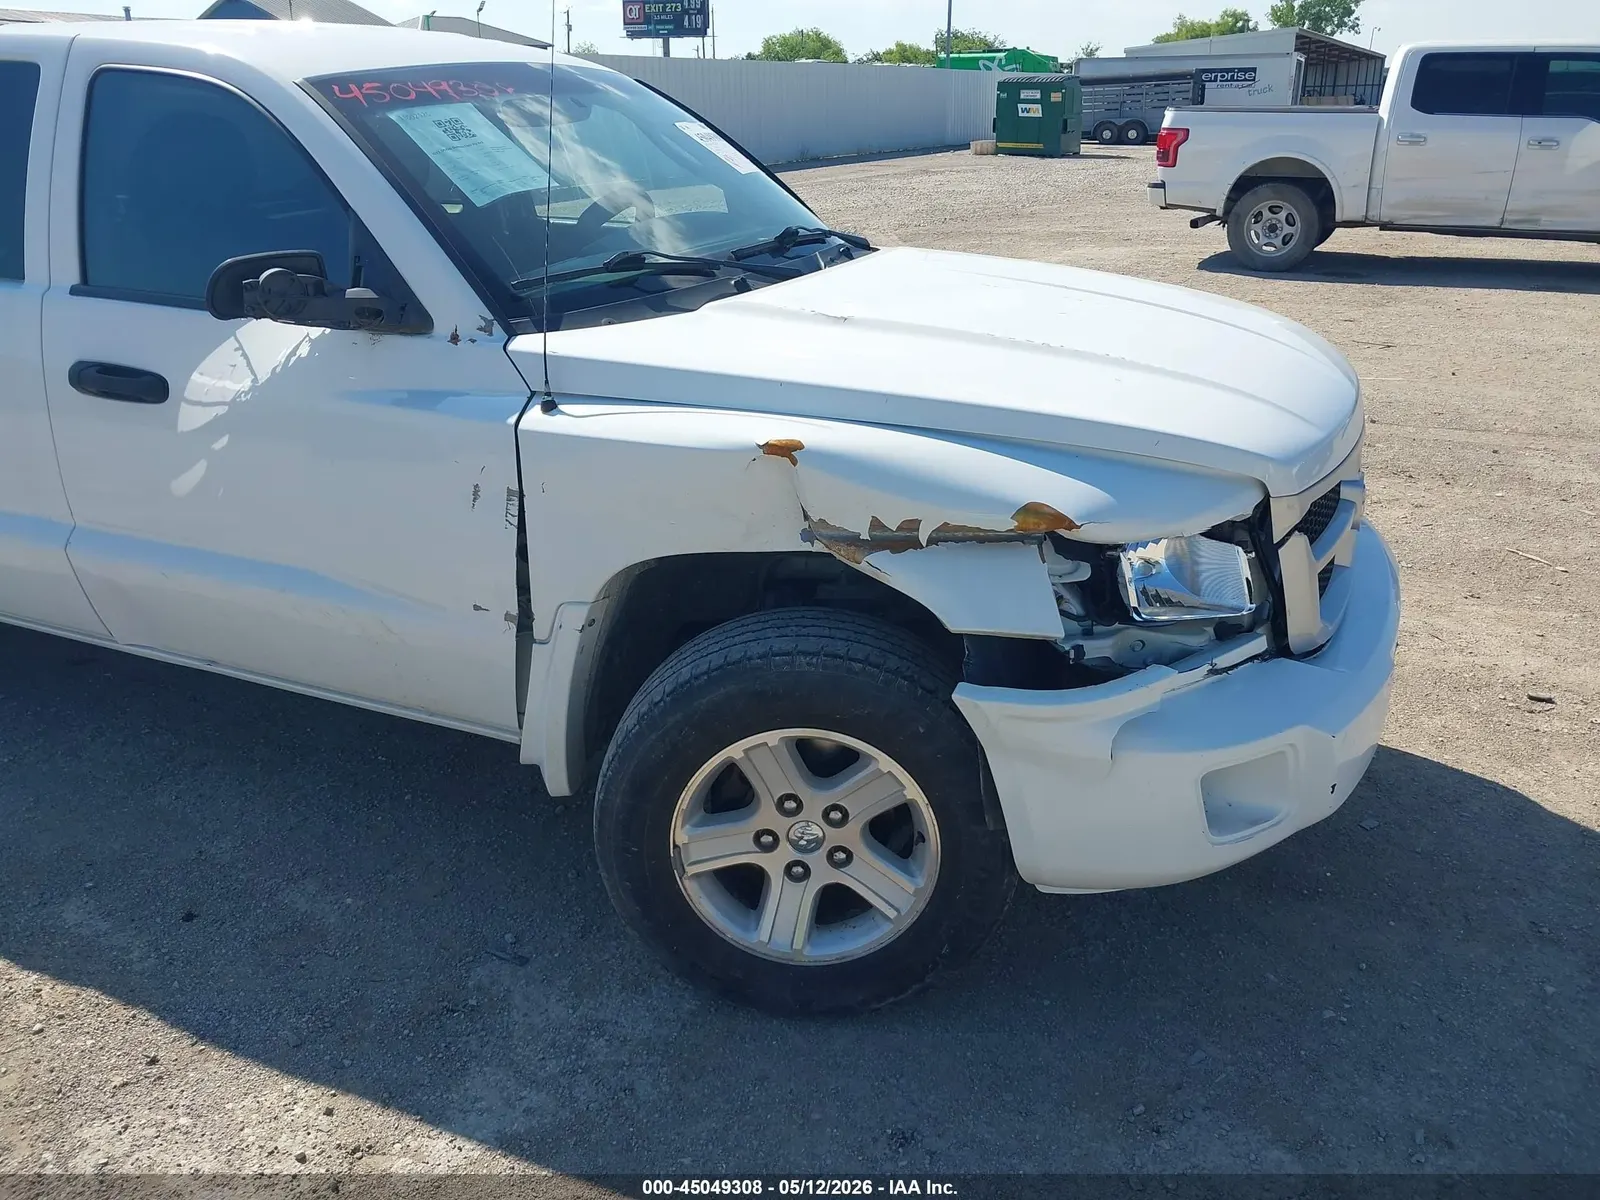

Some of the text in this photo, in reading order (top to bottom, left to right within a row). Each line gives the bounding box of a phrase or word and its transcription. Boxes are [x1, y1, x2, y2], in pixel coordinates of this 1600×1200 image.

[626, 5, 641, 19] QT
[645, 4, 664, 13] EXIT
[665, 3, 682, 12] 273
[1201, 69, 1256, 82] erprise
[1247, 84, 1275, 97] truck
